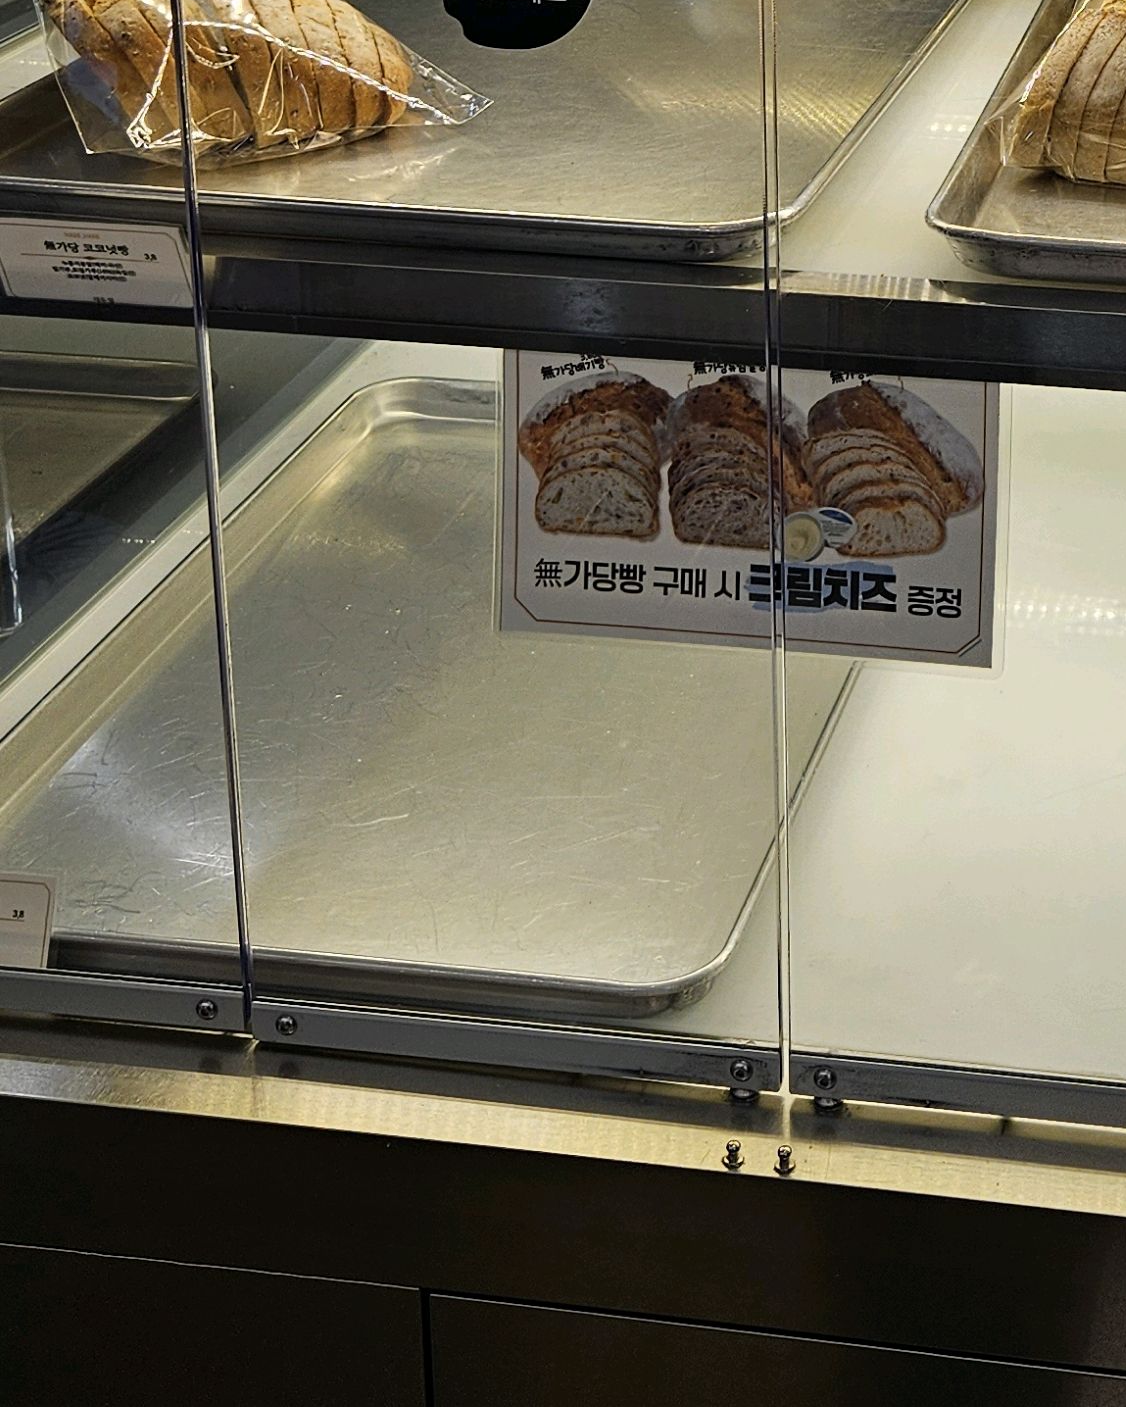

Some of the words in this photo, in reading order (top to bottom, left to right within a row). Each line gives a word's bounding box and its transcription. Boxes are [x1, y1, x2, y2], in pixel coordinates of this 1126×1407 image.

[533, 557, 647, 595] 無가당빵
[653, 565, 707, 600] 구매
[714, 570, 742, 602] 시
[748, 562, 898, 613] 크림치즈
[907, 584, 962, 619] 증정
